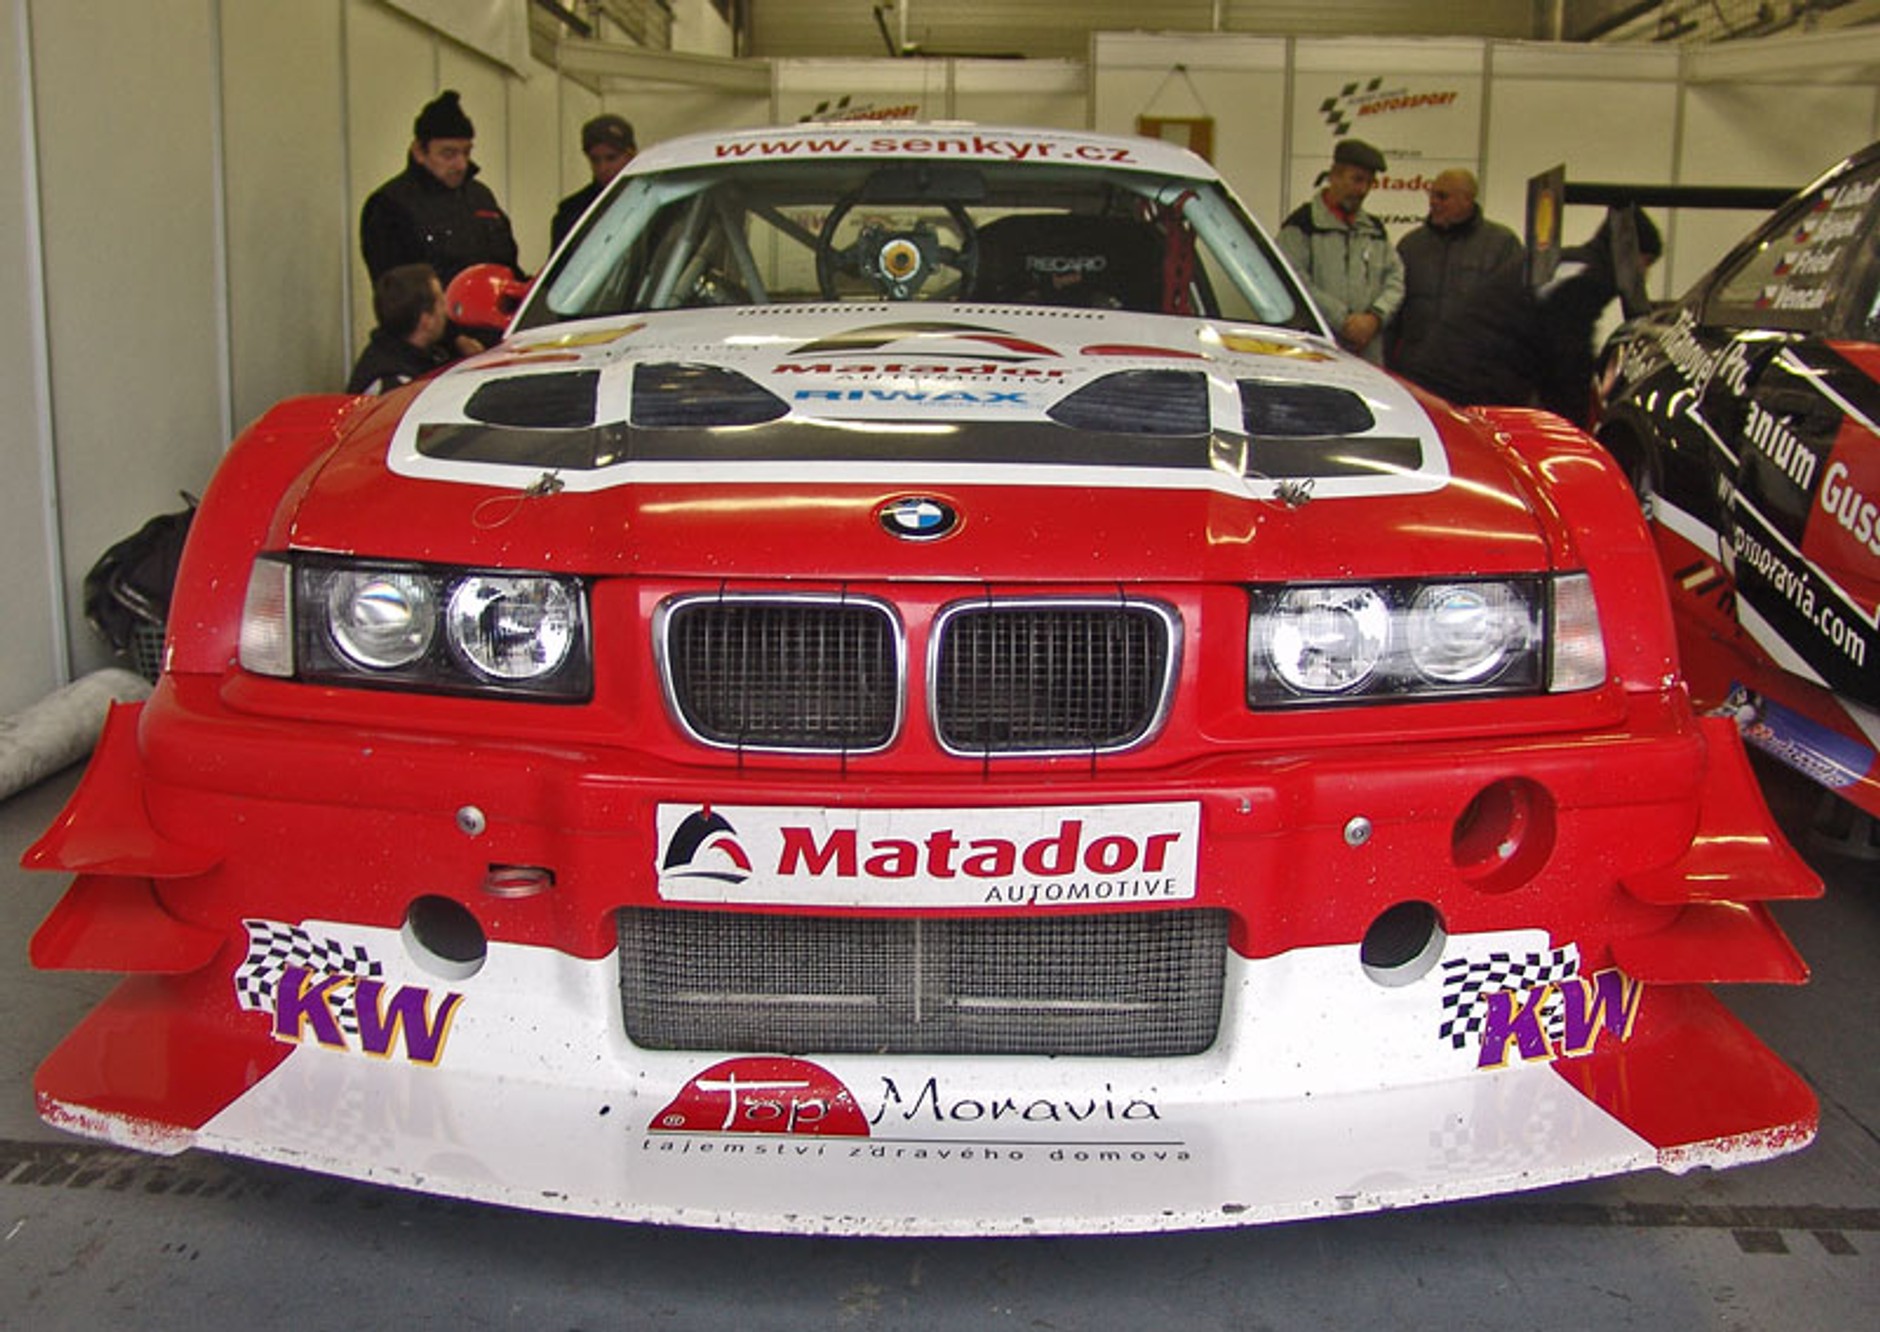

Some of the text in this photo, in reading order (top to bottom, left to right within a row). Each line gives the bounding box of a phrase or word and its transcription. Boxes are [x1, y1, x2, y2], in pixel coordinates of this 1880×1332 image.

[715, 136, 1137, 163] www.senkyr.cz
[771, 364, 1070, 378] Matador
[794, 389, 1025, 404] RIWAX
[778, 820, 1180, 878] Matador
[984, 878, 1176, 902] AUTOMOTIVE
[273, 963, 464, 1068] KW
[1478, 967, 1644, 1071] KW
[695, 1072, 1161, 1133] Top Moravia
[1049, 1148, 1190, 1161] domova
